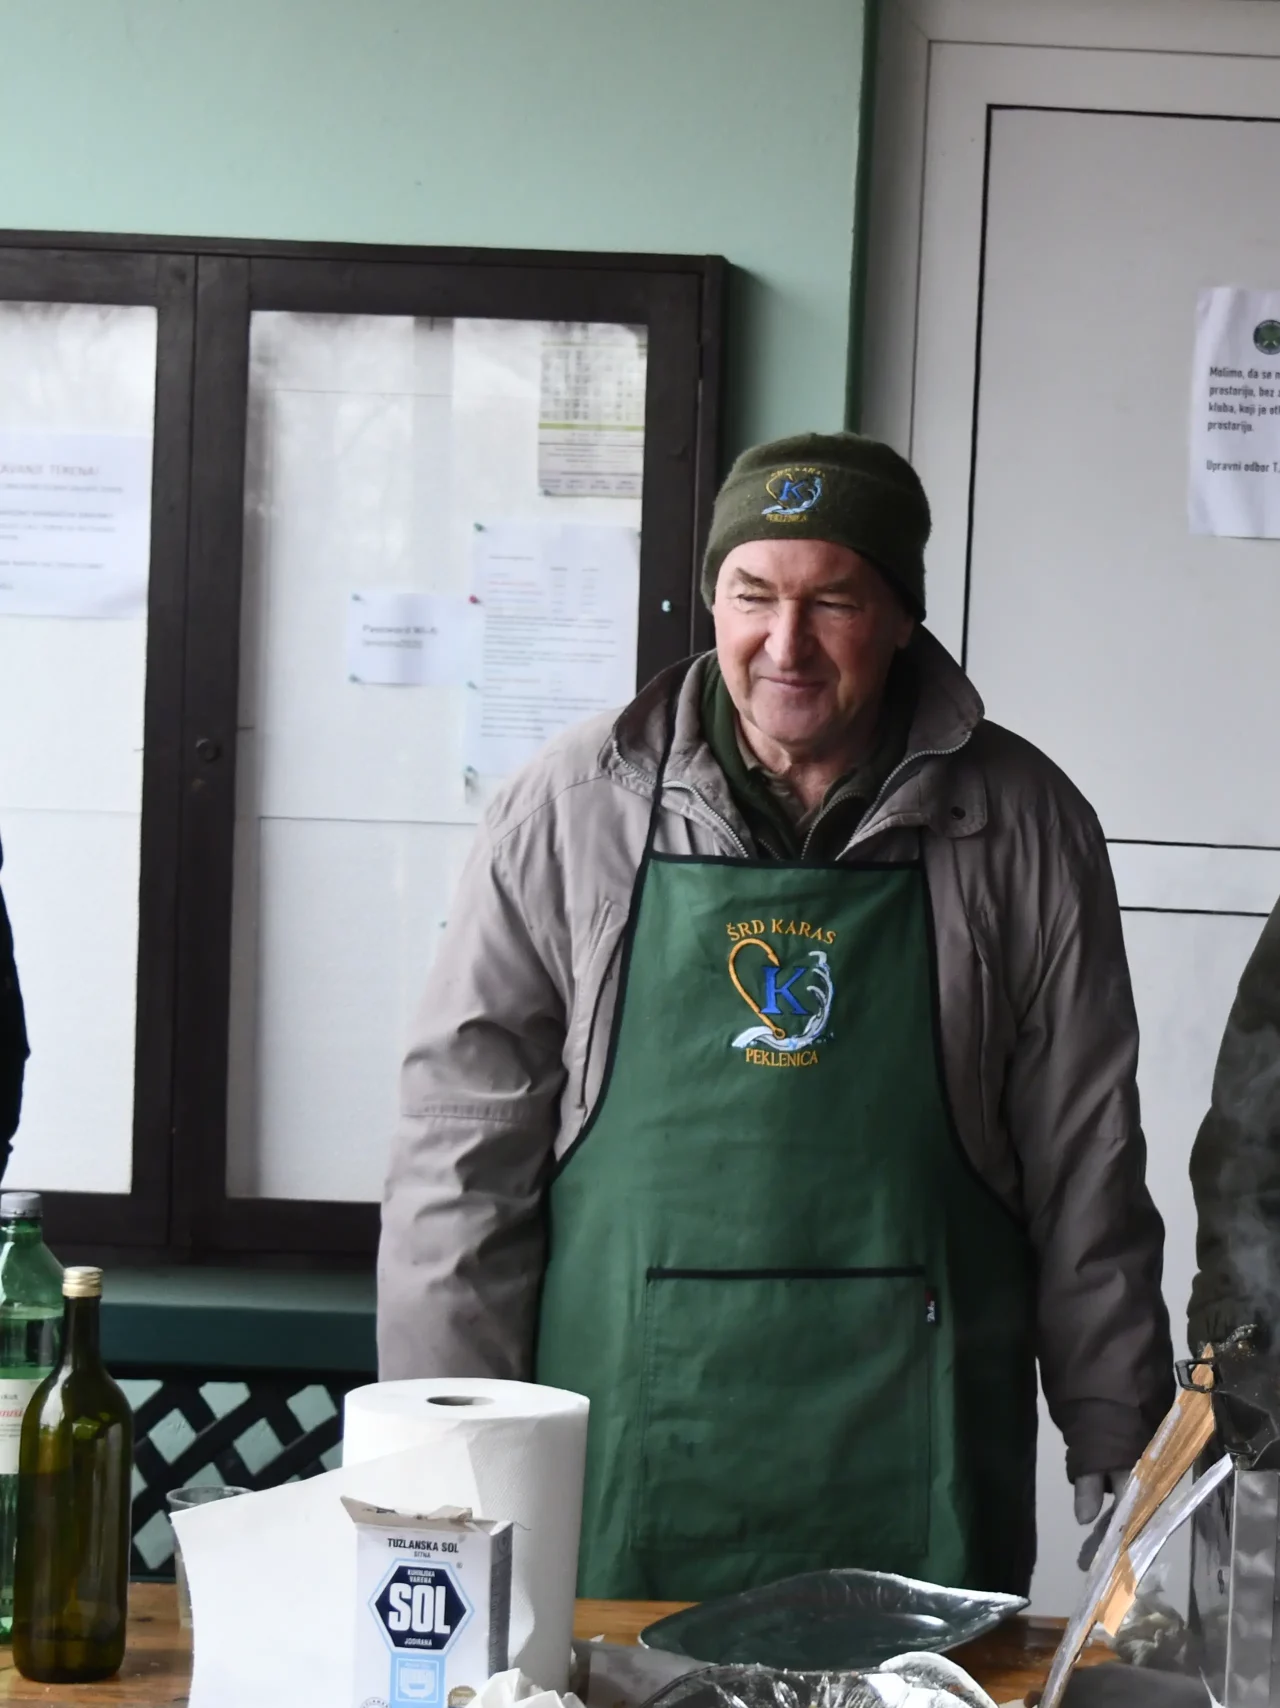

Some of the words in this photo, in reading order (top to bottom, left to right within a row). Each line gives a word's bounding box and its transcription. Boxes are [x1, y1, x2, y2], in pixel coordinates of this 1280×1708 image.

[1210, 367, 1244, 380] Molimo,
[1248, 368, 1259, 379] da
[1262, 370, 1272, 380] se
[1259, 386, 1274, 398] bez
[1208, 402, 1236, 414] kluba,
[1239, 404, 1255, 416] koji
[1258, 404, 1266, 417] je
[1206, 460, 1242, 472] Upravni
[1244, 460, 1270, 473] odbor
[779, 481, 805, 501] K
[726, 919, 765, 941] ŠRD
[772, 918, 837, 944] KARAS
[760, 966, 809, 1015] K
[746, 1047, 818, 1068] PEKLENICA
[388, 1538, 438, 1552] TUZLANSKA
[441, 1542, 460, 1554] SOL
[388, 1583, 451, 1634] SOL
